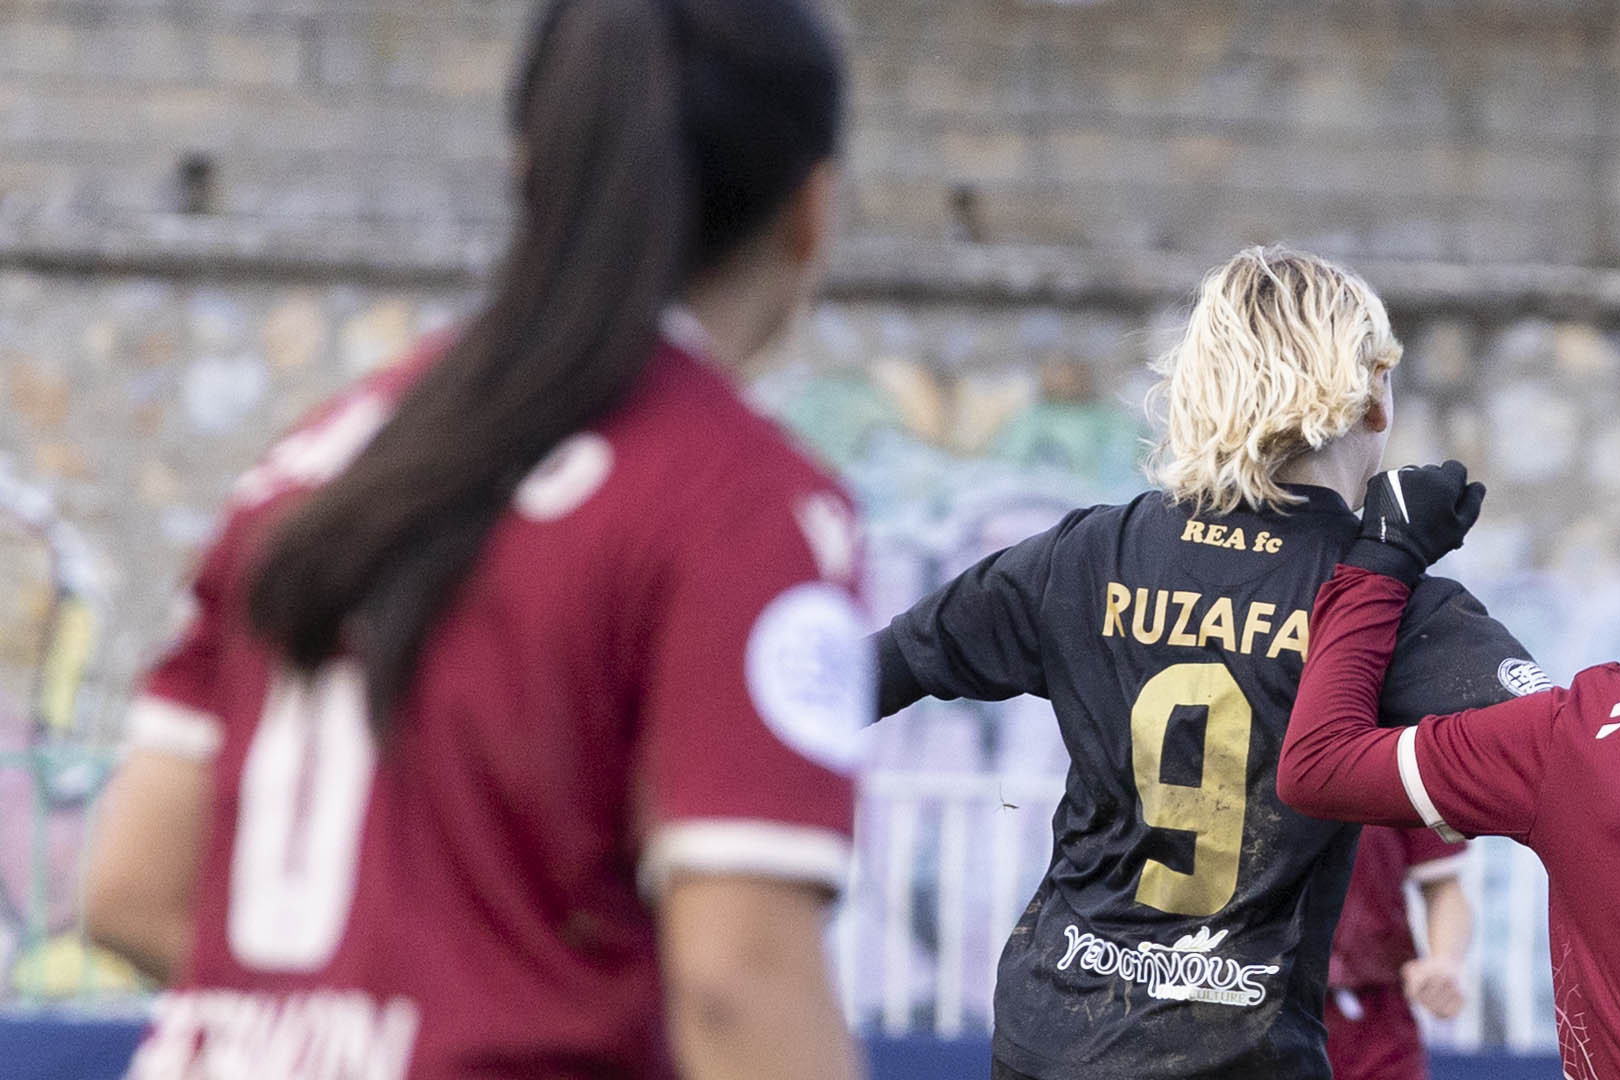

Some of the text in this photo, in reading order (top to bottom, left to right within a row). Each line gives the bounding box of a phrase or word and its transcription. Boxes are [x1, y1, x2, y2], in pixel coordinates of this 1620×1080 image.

[1181, 520, 1284, 554] REA fc
[1102, 581, 1310, 664] RUZAFA
[1130, 662, 1252, 917] 9
